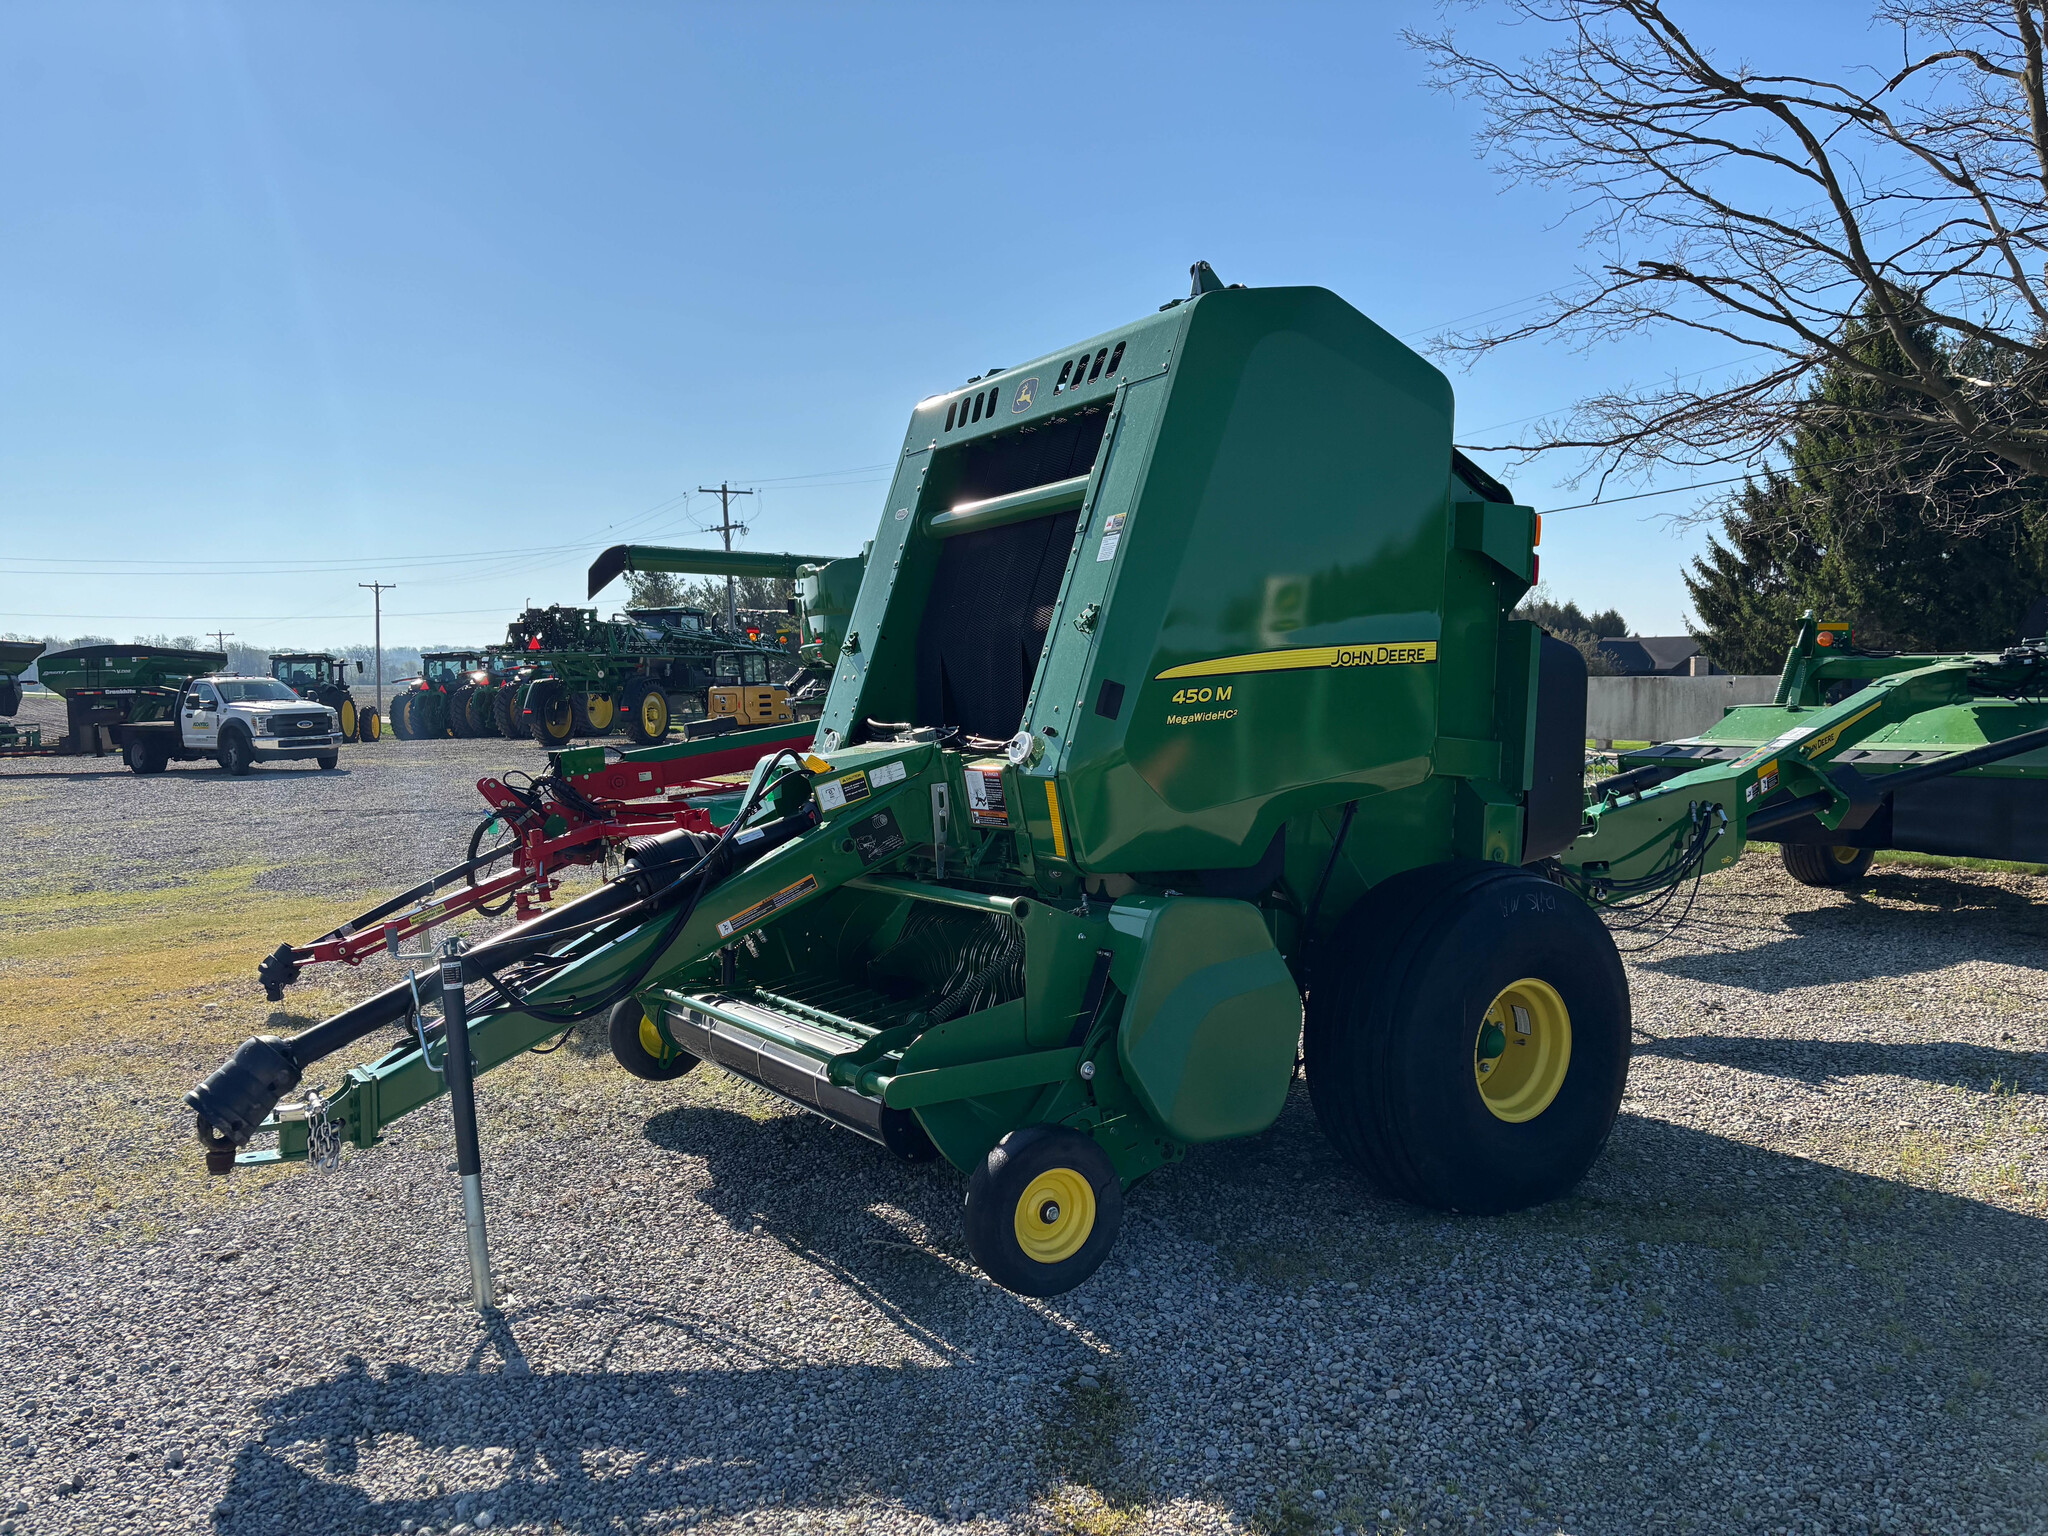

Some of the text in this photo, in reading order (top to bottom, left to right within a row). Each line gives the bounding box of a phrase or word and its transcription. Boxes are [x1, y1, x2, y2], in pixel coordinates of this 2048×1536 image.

[1331, 648, 1426, 666] JOHN DEERE
[1171, 685, 1233, 704] 450 M
[1817, 733, 1835, 749] DEERE
